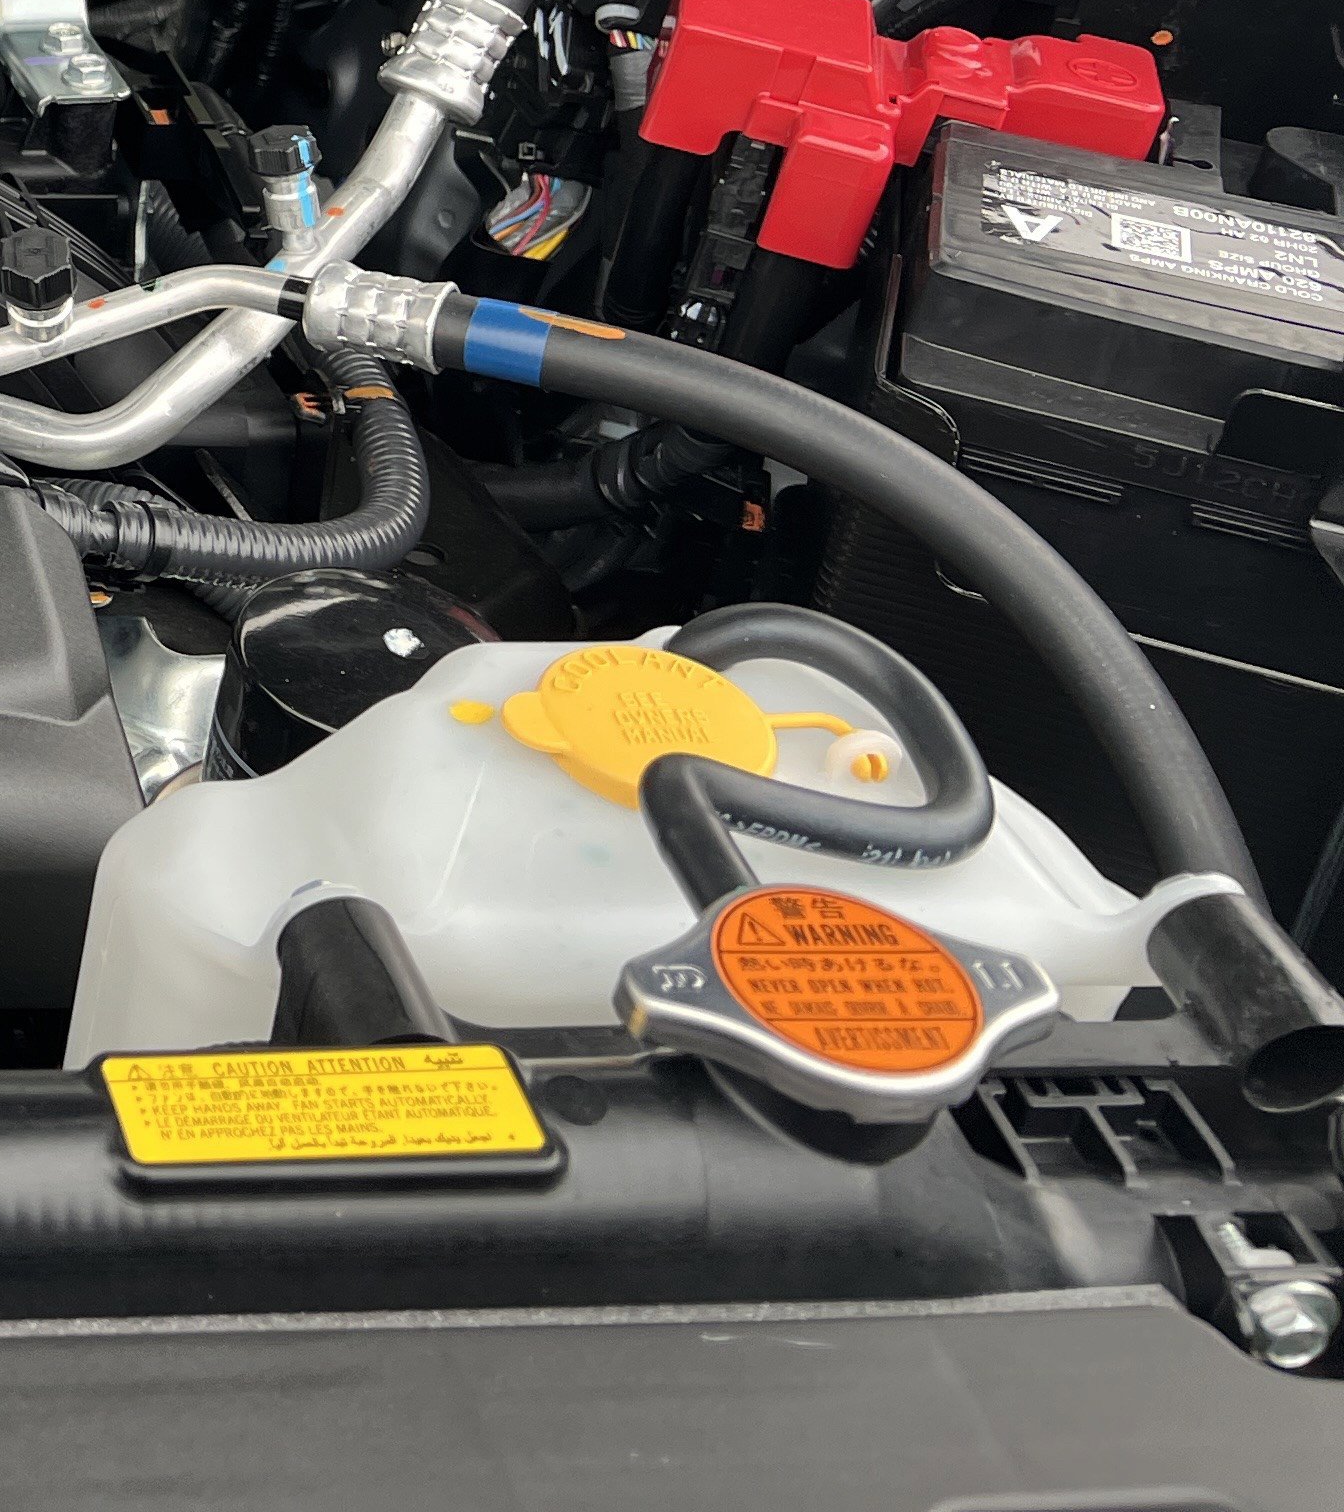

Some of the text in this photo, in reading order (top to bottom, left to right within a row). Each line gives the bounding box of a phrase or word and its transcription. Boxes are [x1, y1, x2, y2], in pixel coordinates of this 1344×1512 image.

[999, 169, 1066, 188] MATERIALS
[1107, 197, 1141, 210] MADE
[1221, 227, 1246, 238] AH
[1219, 250, 1320, 278] GROUP SIZE
[1275, 250, 1318, 268] LN2
[1129, 253, 1323, 301] COLD CRANKING AMPS
[1208, 259, 1321, 292] 620 AMPS
[552, 648, 723, 692] COOLANT
[618, 692, 662, 708] SEE
[622, 727, 710, 744] MANUAL
[768, 897, 846, 920] 警告
[783, 924, 899, 947] WARNING
[747, 978, 802, 994] NEVER
[807, 978, 853, 994] OPEN
[858, 978, 908, 994] WHEN
[159, 1063, 198, 1079] 注意
[212, 1056, 406, 1077] CAUTION ATTENTION
[152, 1103, 187, 1116] KEEP
[193, 1101, 241, 1114] HANDS
[293, 1099, 319, 1111] FAN
[323, 1097, 375, 1110] STARTS
[156, 1117, 171, 1129] LE
[281, 1124, 305, 1136] PAS
[308, 1123, 333, 1135] LES
